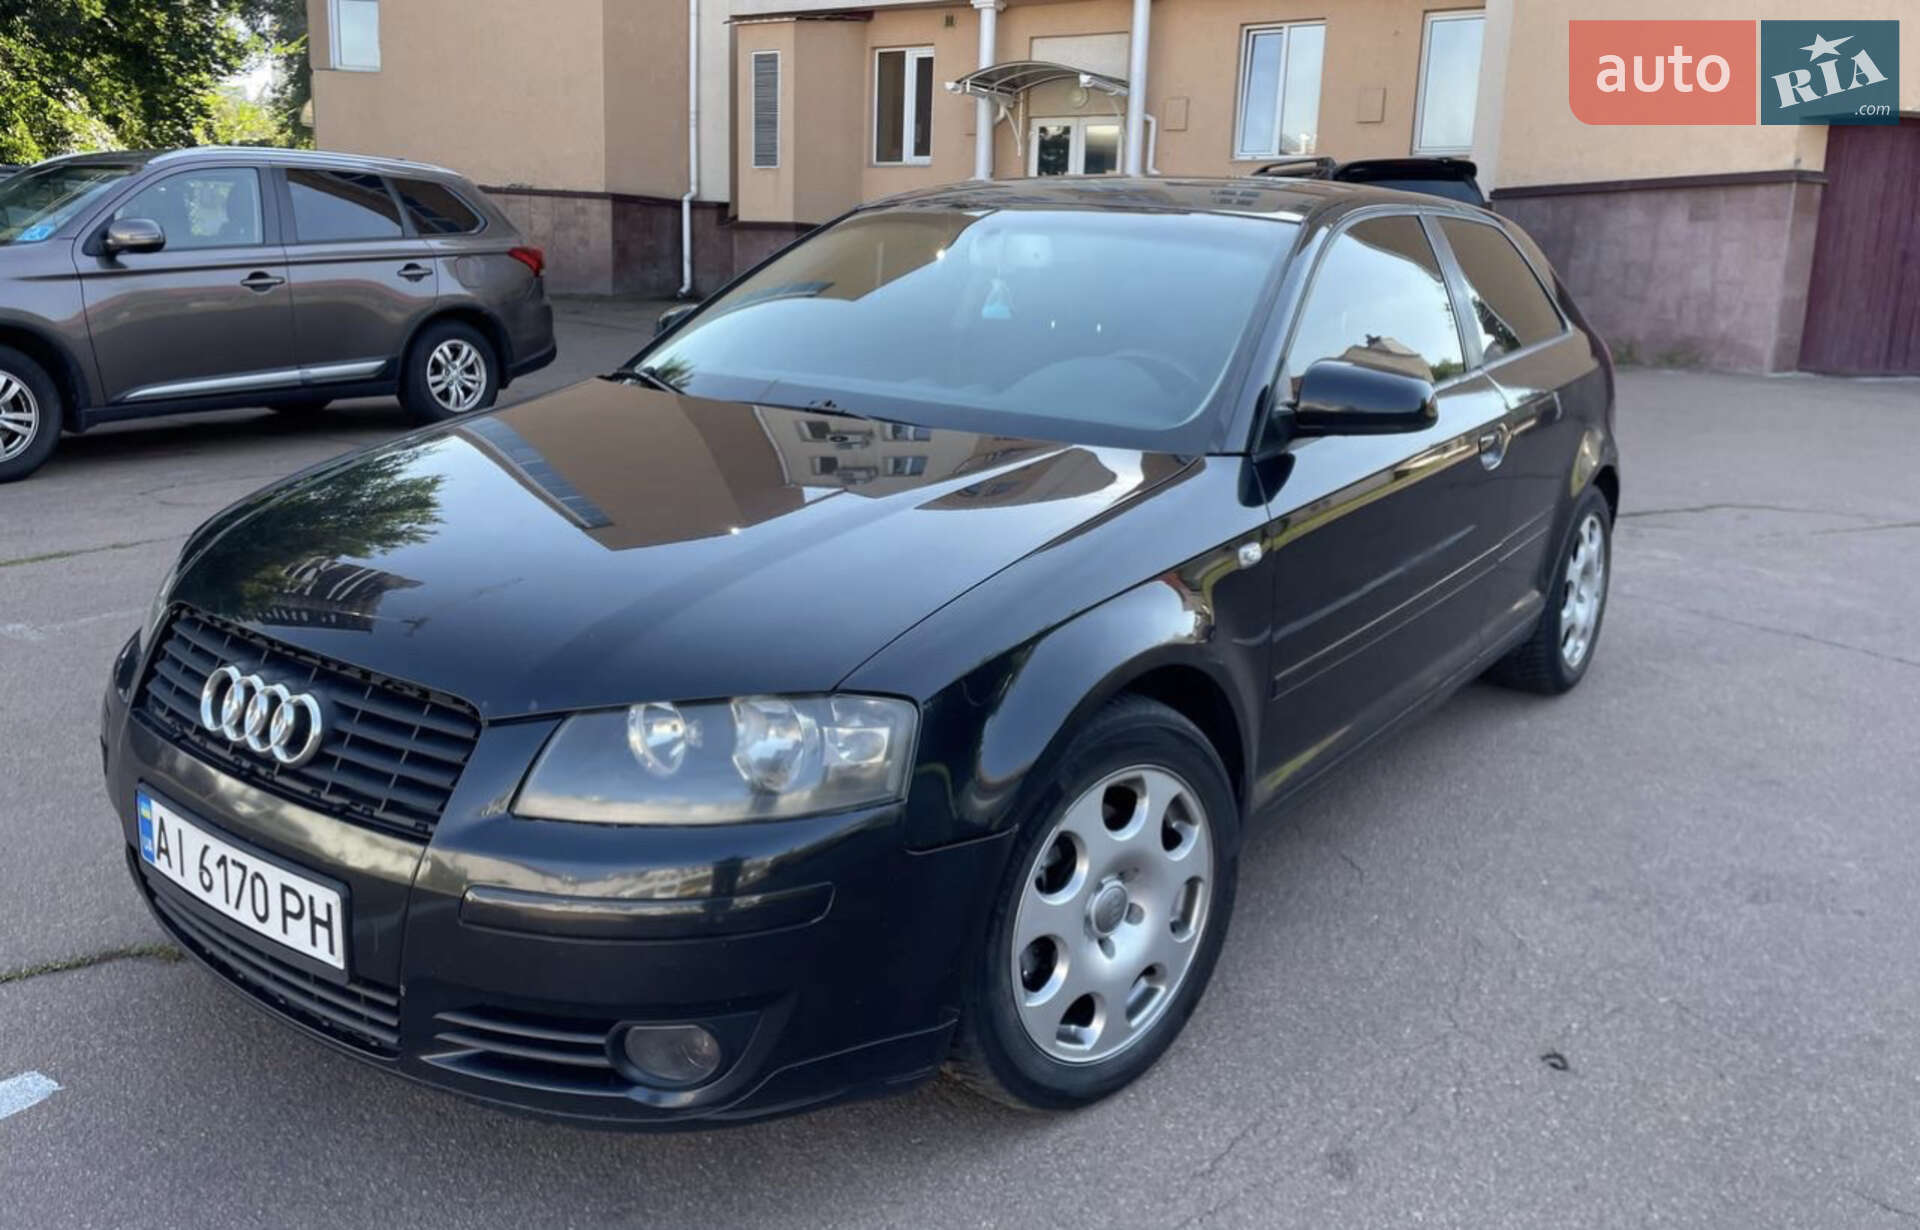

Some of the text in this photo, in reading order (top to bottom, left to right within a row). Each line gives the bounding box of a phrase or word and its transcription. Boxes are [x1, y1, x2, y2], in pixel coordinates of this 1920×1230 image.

[157, 816, 335, 956] AI 6170 PH
